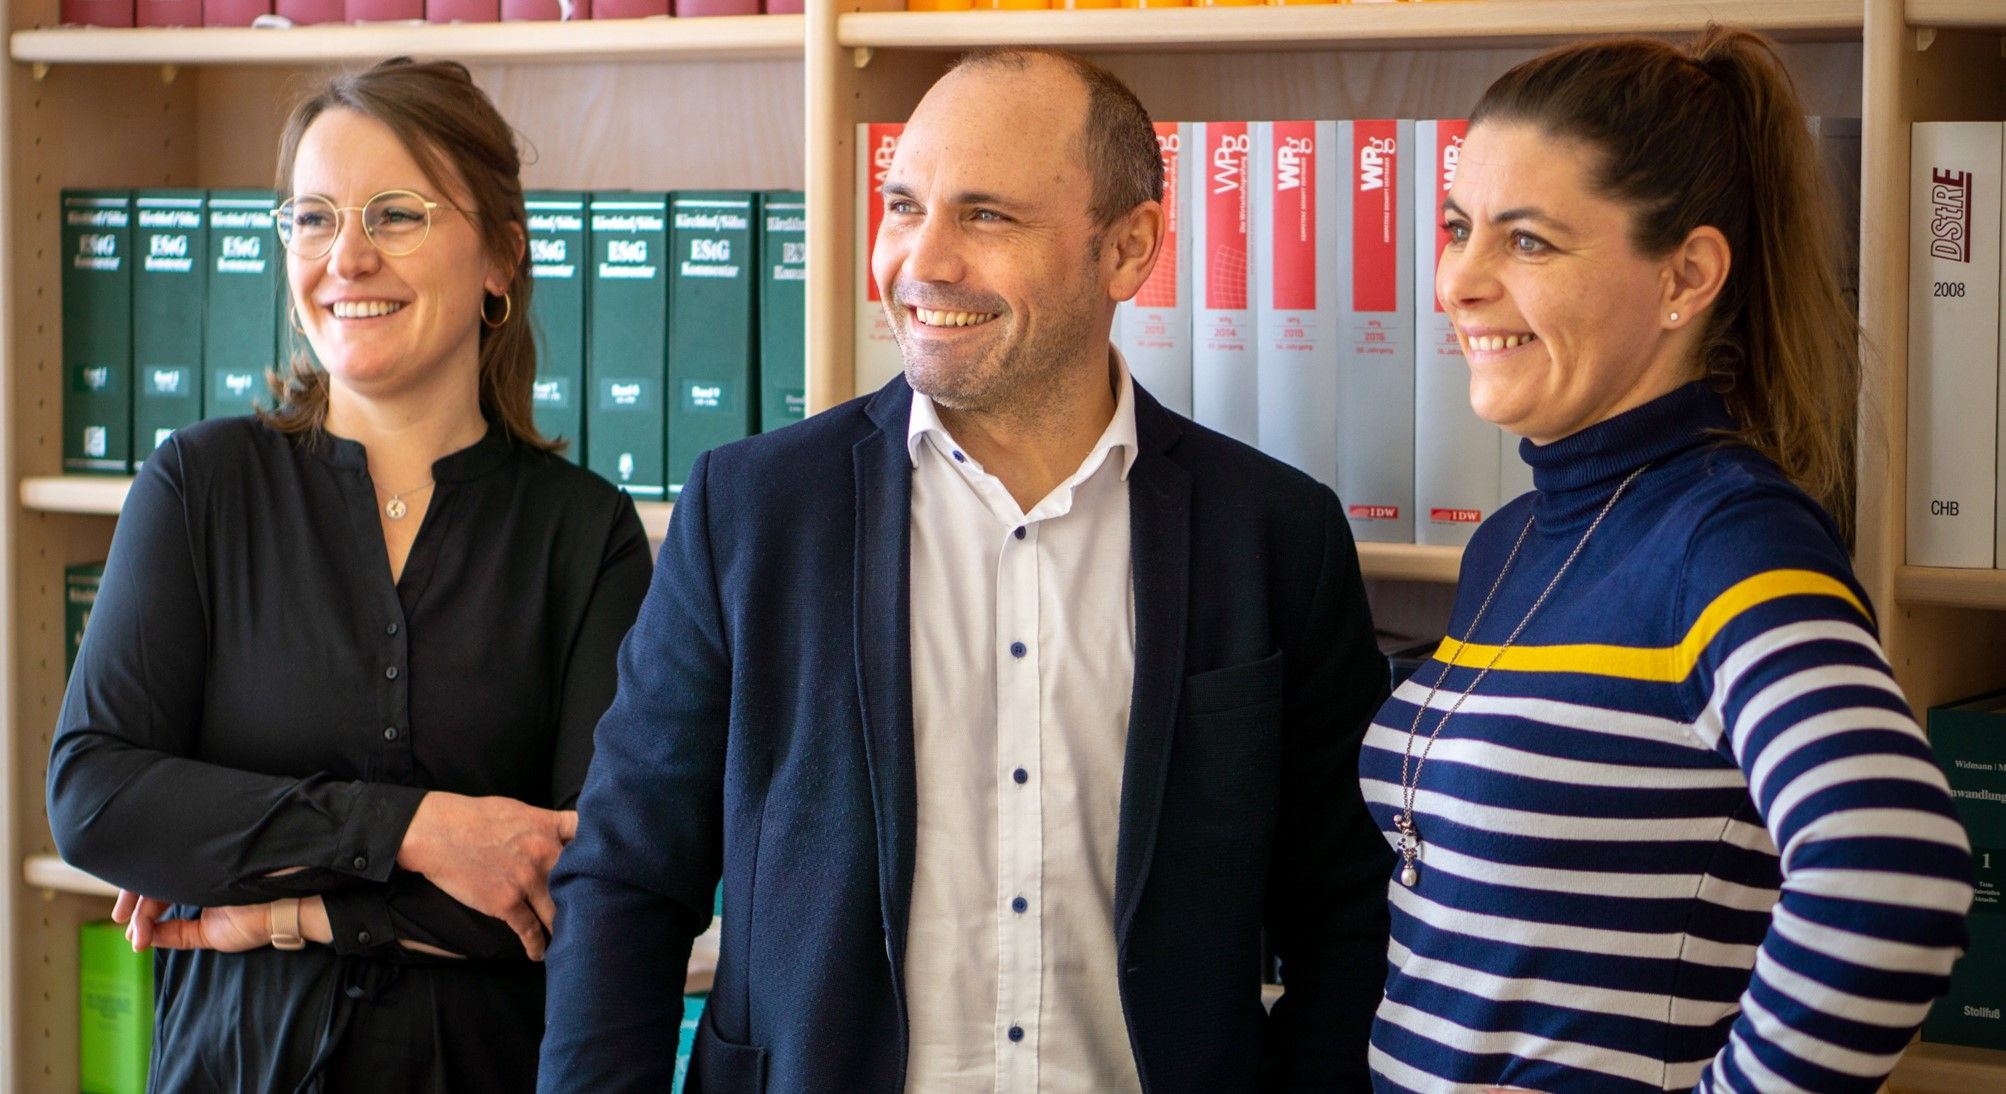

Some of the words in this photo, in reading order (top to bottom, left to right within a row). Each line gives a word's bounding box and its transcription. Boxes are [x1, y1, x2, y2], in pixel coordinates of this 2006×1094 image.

[1213, 133, 1250, 194] WPg
[1277, 136, 1313, 191] WPg
[1360, 136, 1396, 191] WPg
[1931, 167, 1964, 262] DStRE
[607, 240, 647, 262] EStG
[690, 239, 731, 261] EStG
[1934, 282, 1965, 297] 2008
[1214, 327, 1237, 338] 2014
[1370, 508, 1396, 517] IDW
[1452, 511, 1479, 520] IDW
[1931, 500, 1959, 516] CHB
[1955, 760, 1993, 771] Widmann
[1982, 853, 1991, 869] 1
